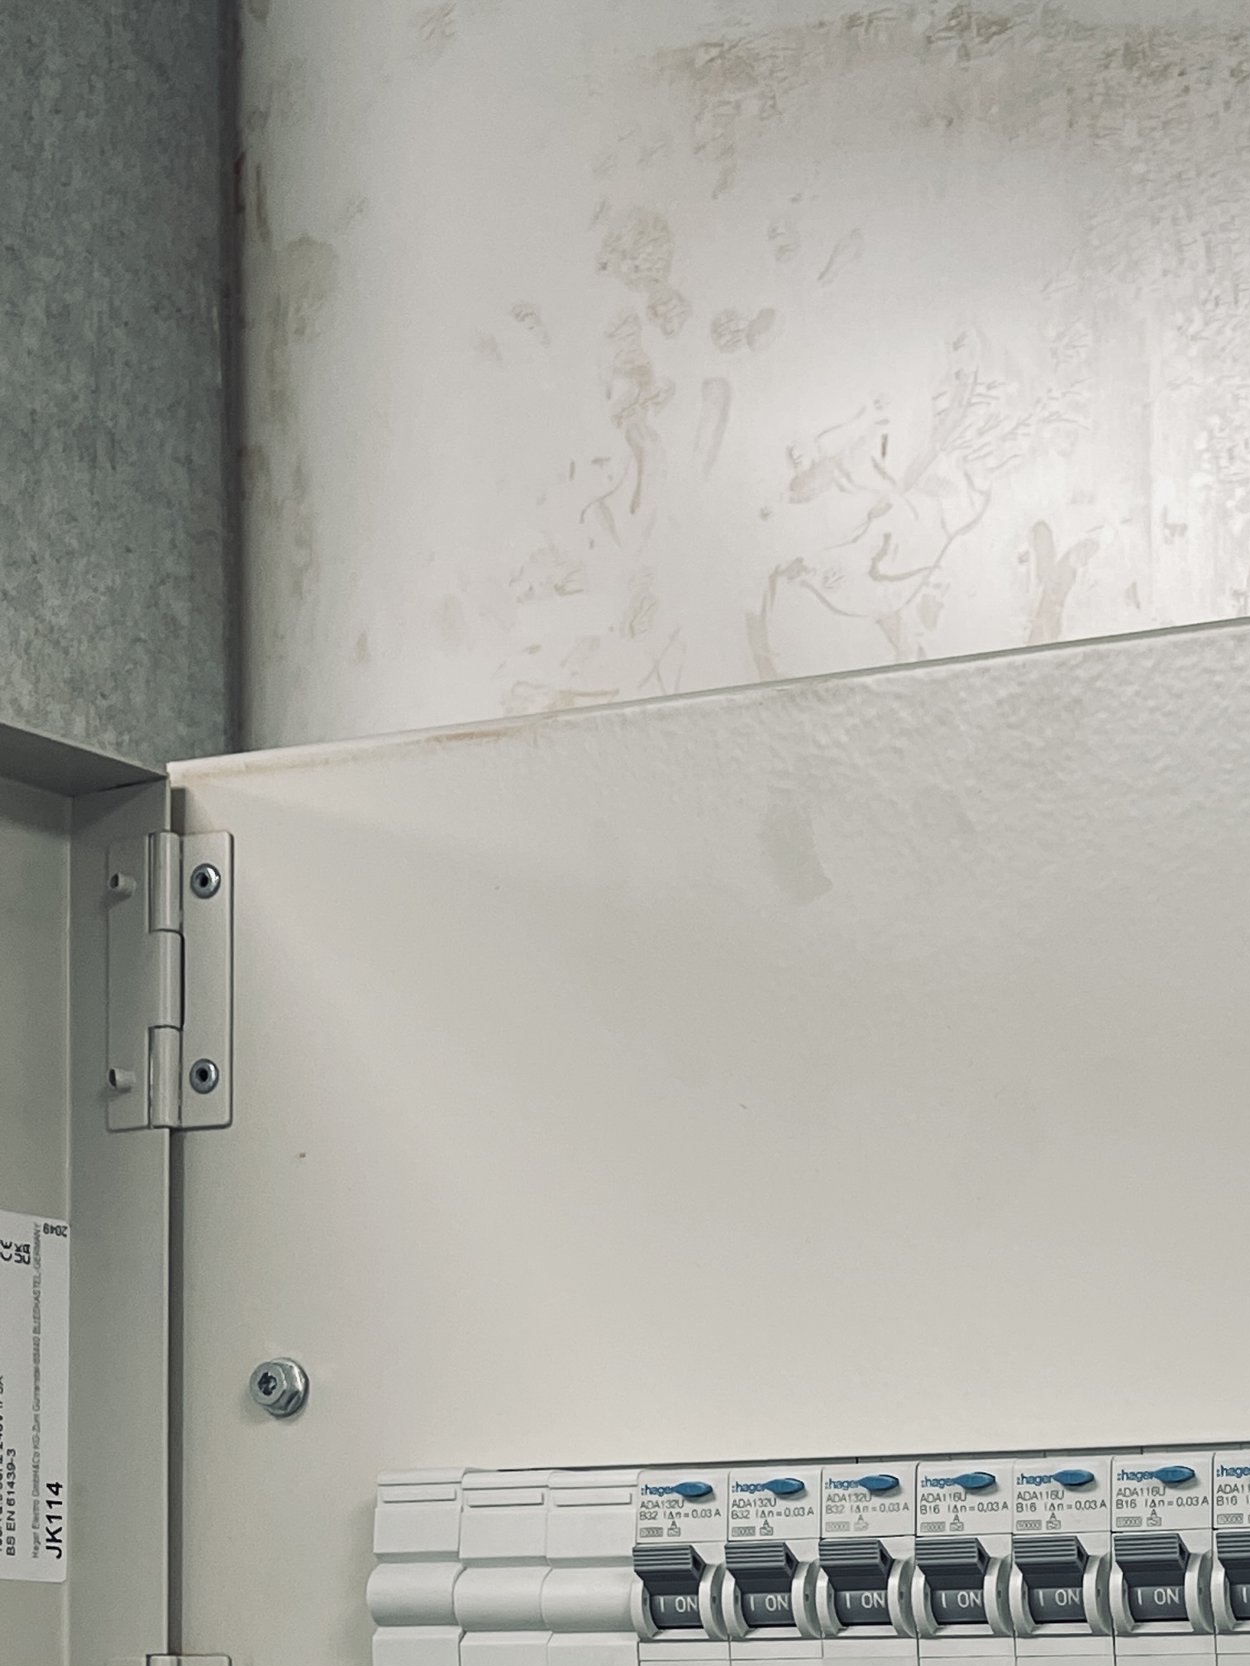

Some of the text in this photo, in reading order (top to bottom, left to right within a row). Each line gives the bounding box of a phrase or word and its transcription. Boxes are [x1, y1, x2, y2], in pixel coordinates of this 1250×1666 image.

[6, 1449, 16, 1556] BS EN 61439-3
[1016, 1502, 1037, 1513] B16
[1116, 1499, 1137, 1509] B16
[45, 1482, 63, 1559] JK114
[675, 1595, 698, 1613] ON
[765, 1595, 791, 1612] ON
[862, 1592, 886, 1609] ON
[958, 1590, 983, 1608] ON
[1055, 1587, 1081, 1606] ON
[1154, 1587, 1180, 1605] ON
